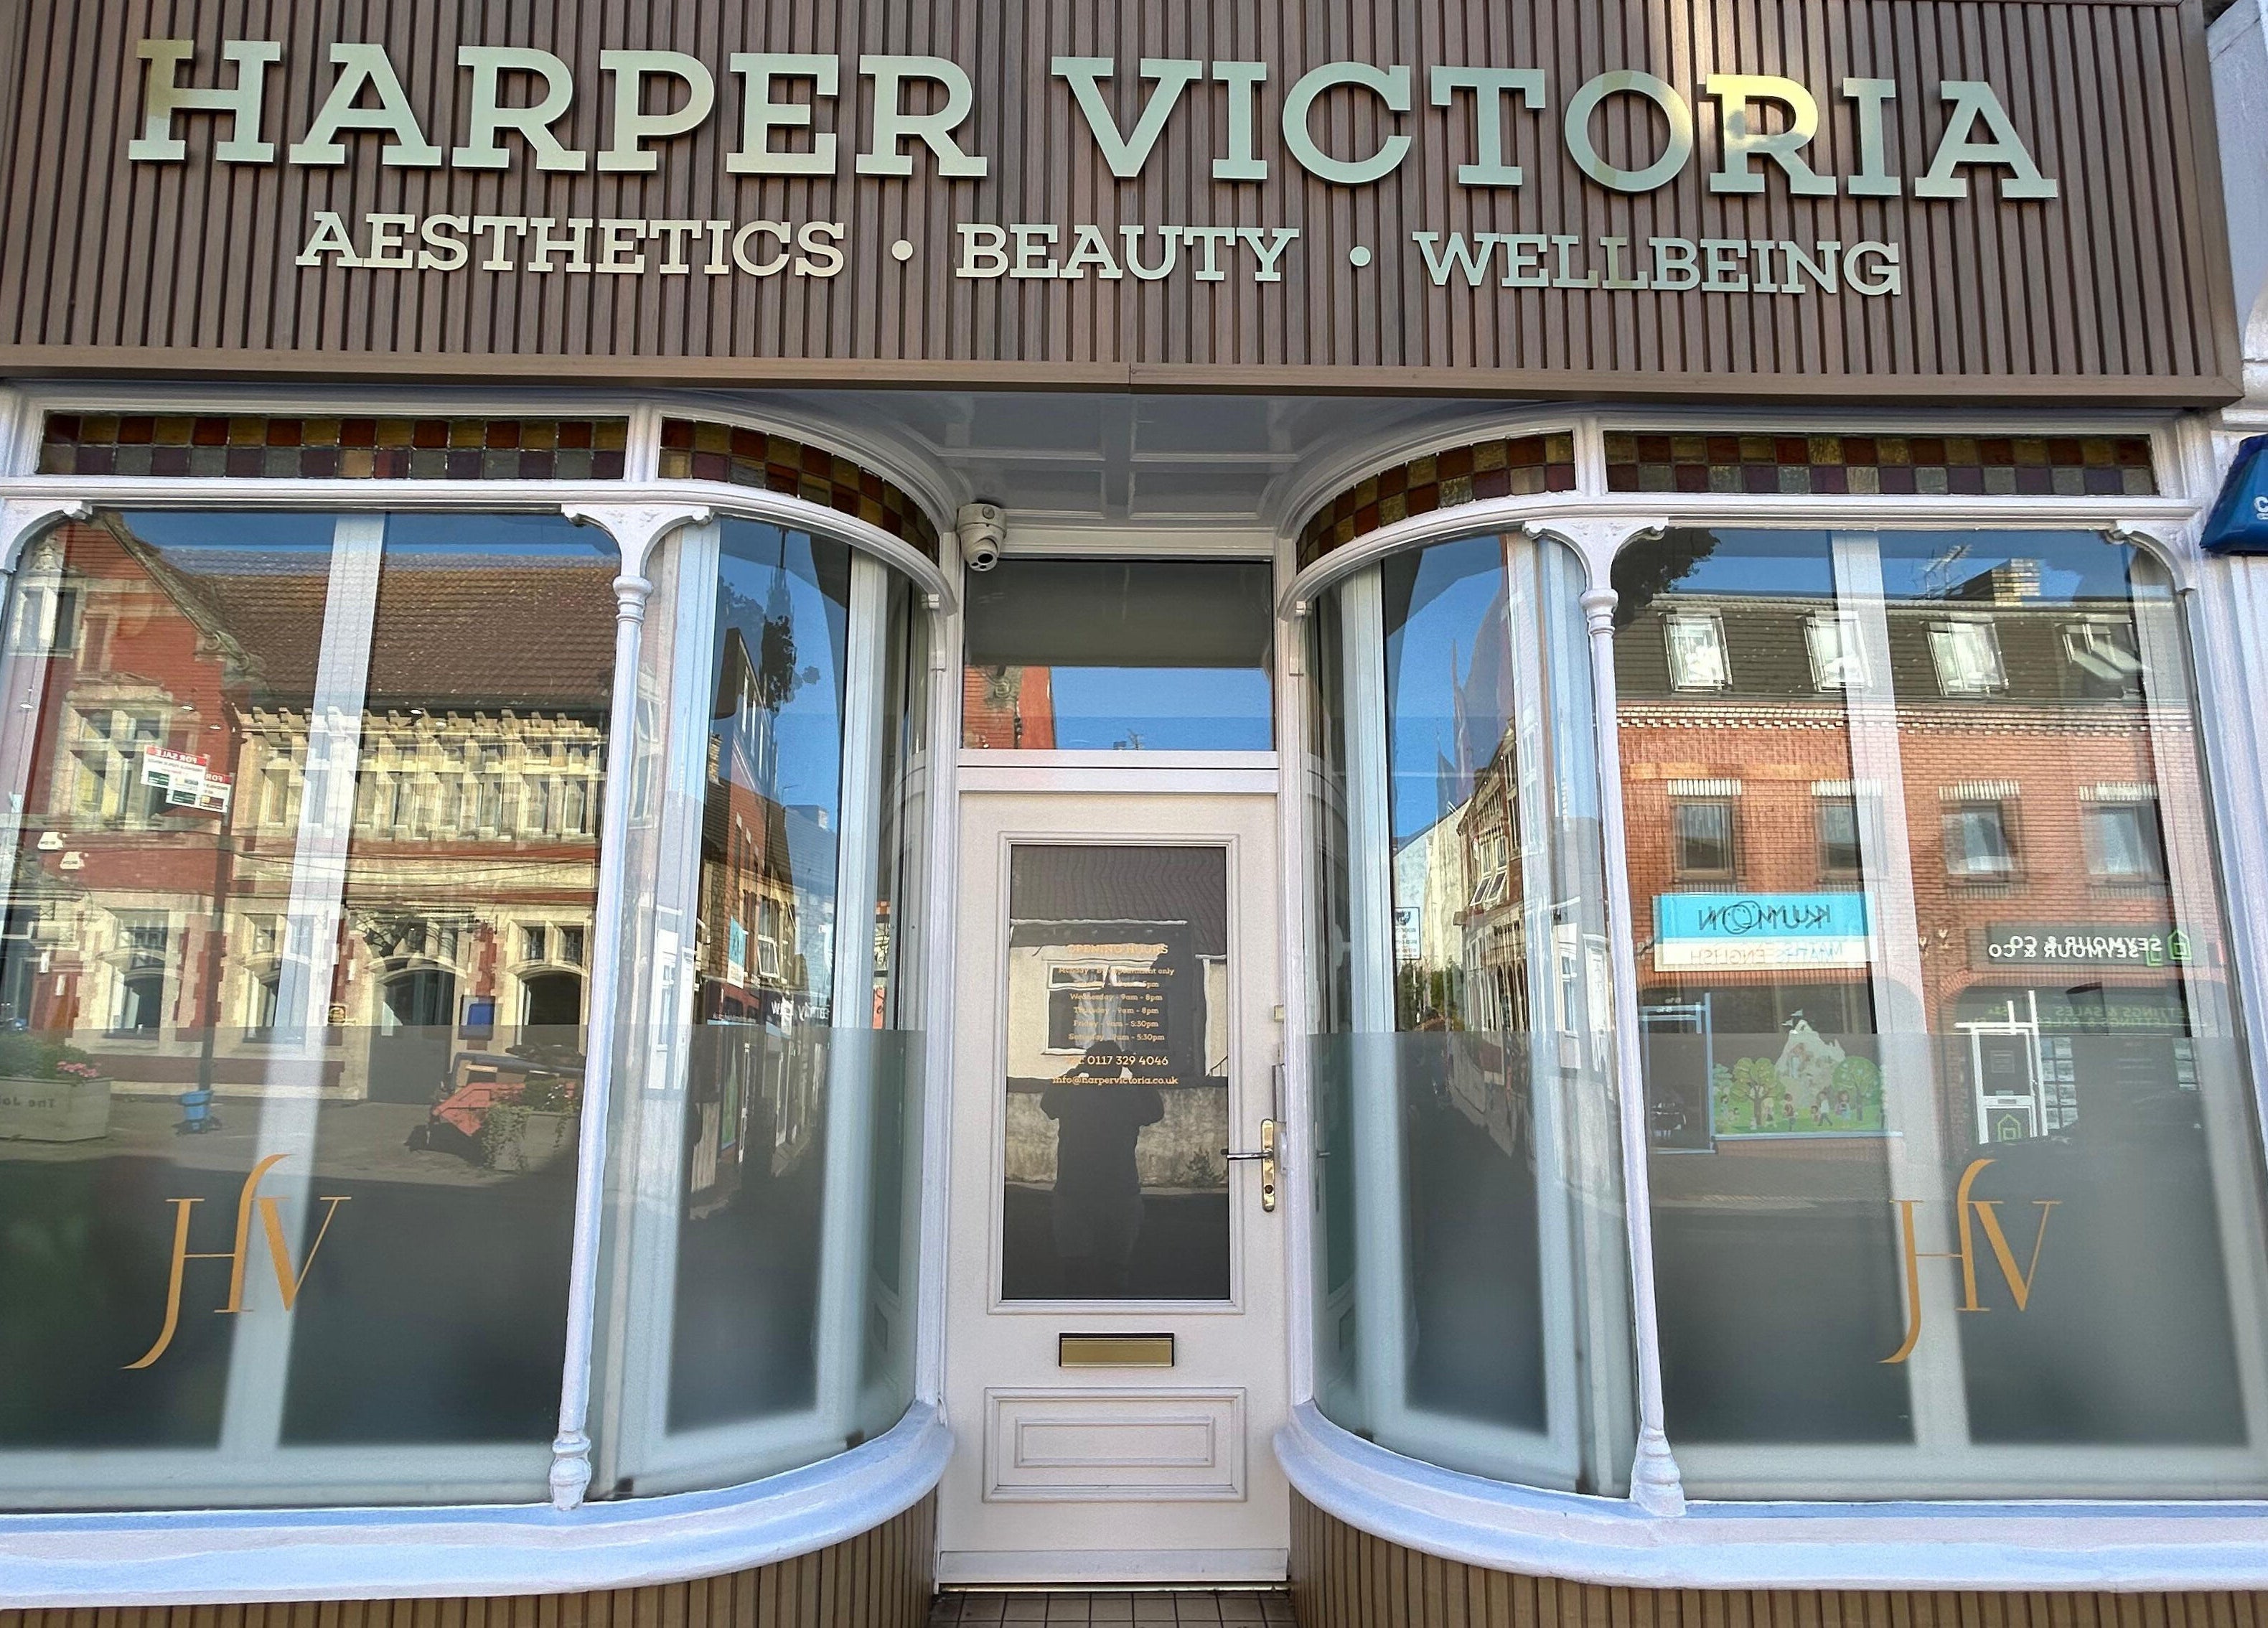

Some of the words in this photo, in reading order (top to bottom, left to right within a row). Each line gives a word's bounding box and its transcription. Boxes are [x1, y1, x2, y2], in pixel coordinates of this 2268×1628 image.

[128, 39, 988, 178] HARPER
[1051, 55, 2059, 200] VICTORIA
[295, 210, 845, 279] AESTHETICS
[955, 223, 1301, 282] BEAUTY
[1411, 230, 1902, 296] WELLBEING
[1067, 943, 1123, 955] OPENING
[1127, 943, 1169, 955] HOURS
[1158, 967, 1175, 976] only
[1069, 993, 1113, 1003] Wednesday
[1120, 993, 1138, 1001] 9am
[1145, 993, 1163, 1003] 8pm
[1073, 1007, 1110, 1016] Thursday
[1141, 1007, 1160, 1016] 8pm
[1073, 1020, 1100, 1029] Friday
[1130, 1020, 1159, 1029] 5:30pm
[1068, 1034, 1104, 1043] Saturday
[1136, 1034, 1166, 1043] 5:30pm
[1087, 1055, 1112, 1066] 0117
[1115, 1055, 1136, 1066] 329
[1138, 1055, 1169, 1066] 4046
